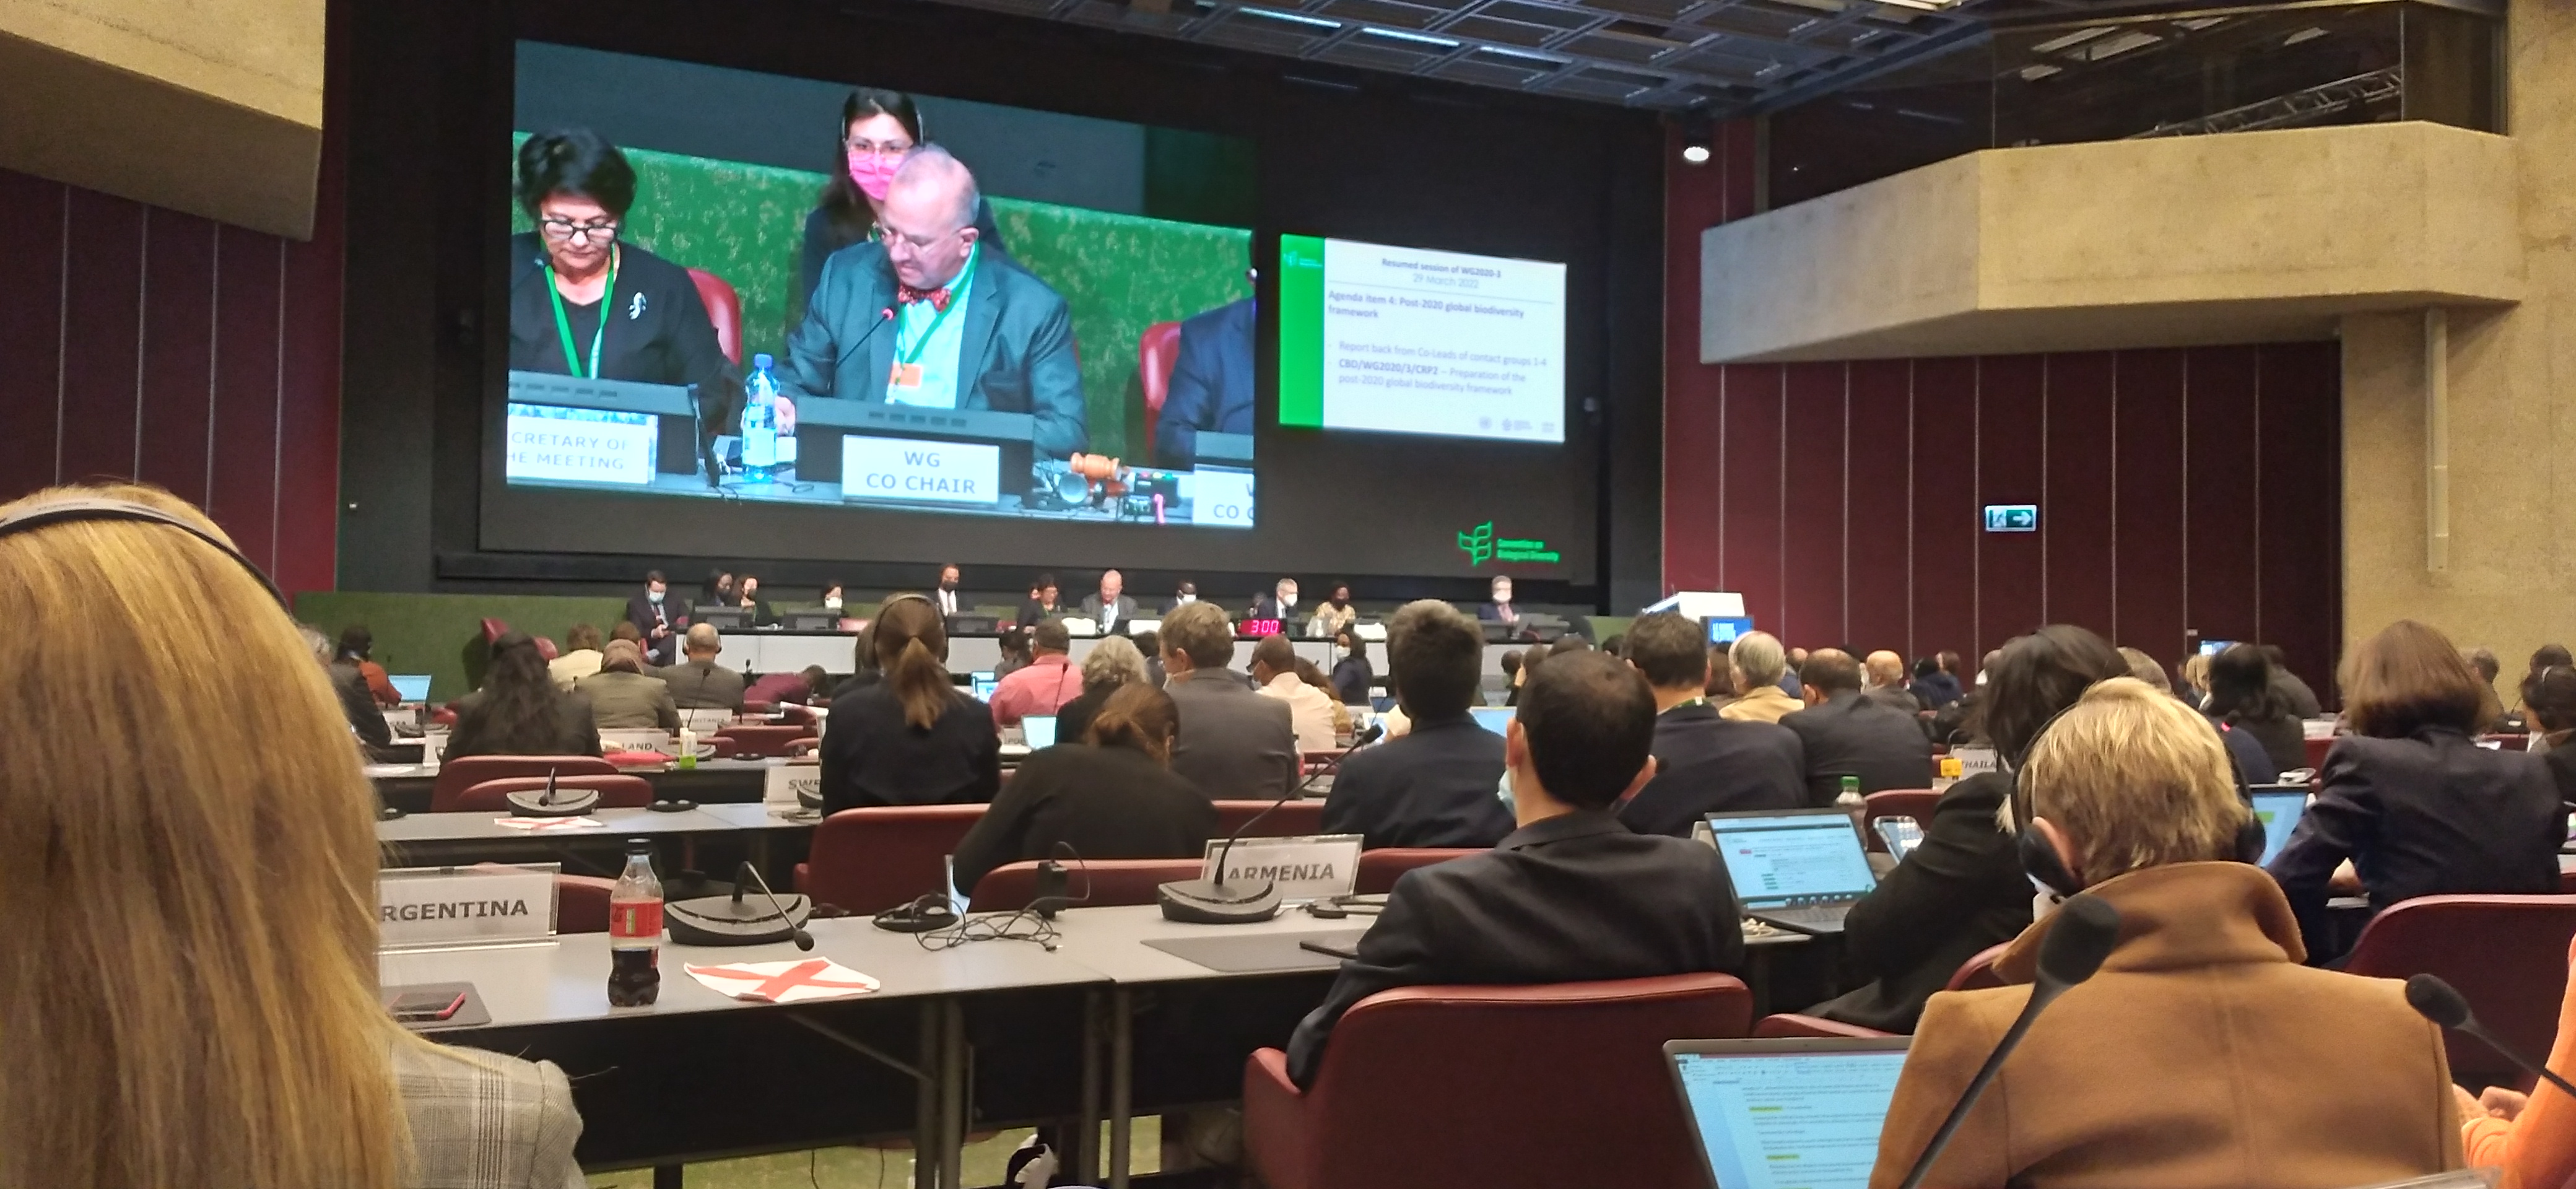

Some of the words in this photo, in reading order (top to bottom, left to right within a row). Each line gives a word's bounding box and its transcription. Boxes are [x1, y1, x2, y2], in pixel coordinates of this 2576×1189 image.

[1382, 258, 1419, 269] Resumed
[1421, 264, 1449, 272] session
[1461, 266, 1502, 277] WG2020-3
[1414, 273, 1424, 282] 29
[1426, 276, 1455, 286] March
[1459, 279, 1479, 289] 2022
[1328, 304, 1378, 318] framework
[1329, 290, 1363, 302] Agenda
[1365, 294, 1386, 304] item
[1389, 296, 1397, 305] 4:
[1399, 297, 1443, 310] Post-2020
[1445, 302, 1472, 313] global
[1474, 304, 1524, 319] biodiversity
[1339, 341, 1369, 352] Report
[1372, 343, 1391, 354] back
[1395, 345, 1416, 355] from
[1417, 347, 1456, 359] Co-Leads
[1458, 351, 1467, 360] of
[1470, 354, 1500, 363] contact
[1503, 357, 1531, 366] groups
[1534, 357, 1547, 365] 1-4
[1450, 367, 1499, 380] Preparation
[1501, 372, 1510, 381] of
[1512, 373, 1526, 382] the
[1339, 375, 1384, 386] post-2020
[1386, 378, 1412, 388] global
[1415, 380, 1464, 393] biodiversity
[1466, 382, 1512, 394] framework
[511, 432, 599, 449] CRETARY
[507, 451, 528, 463] HE
[537, 453, 624, 470] MEETING
[904, 450, 941, 468] WG
[866, 473, 897, 489] CO
[905, 475, 976, 494] CHAIR
[1213, 504, 1240, 519] CO
[1228, 862, 1334, 881] ARMENIA
[380, 899, 529, 922] RGENTINA
